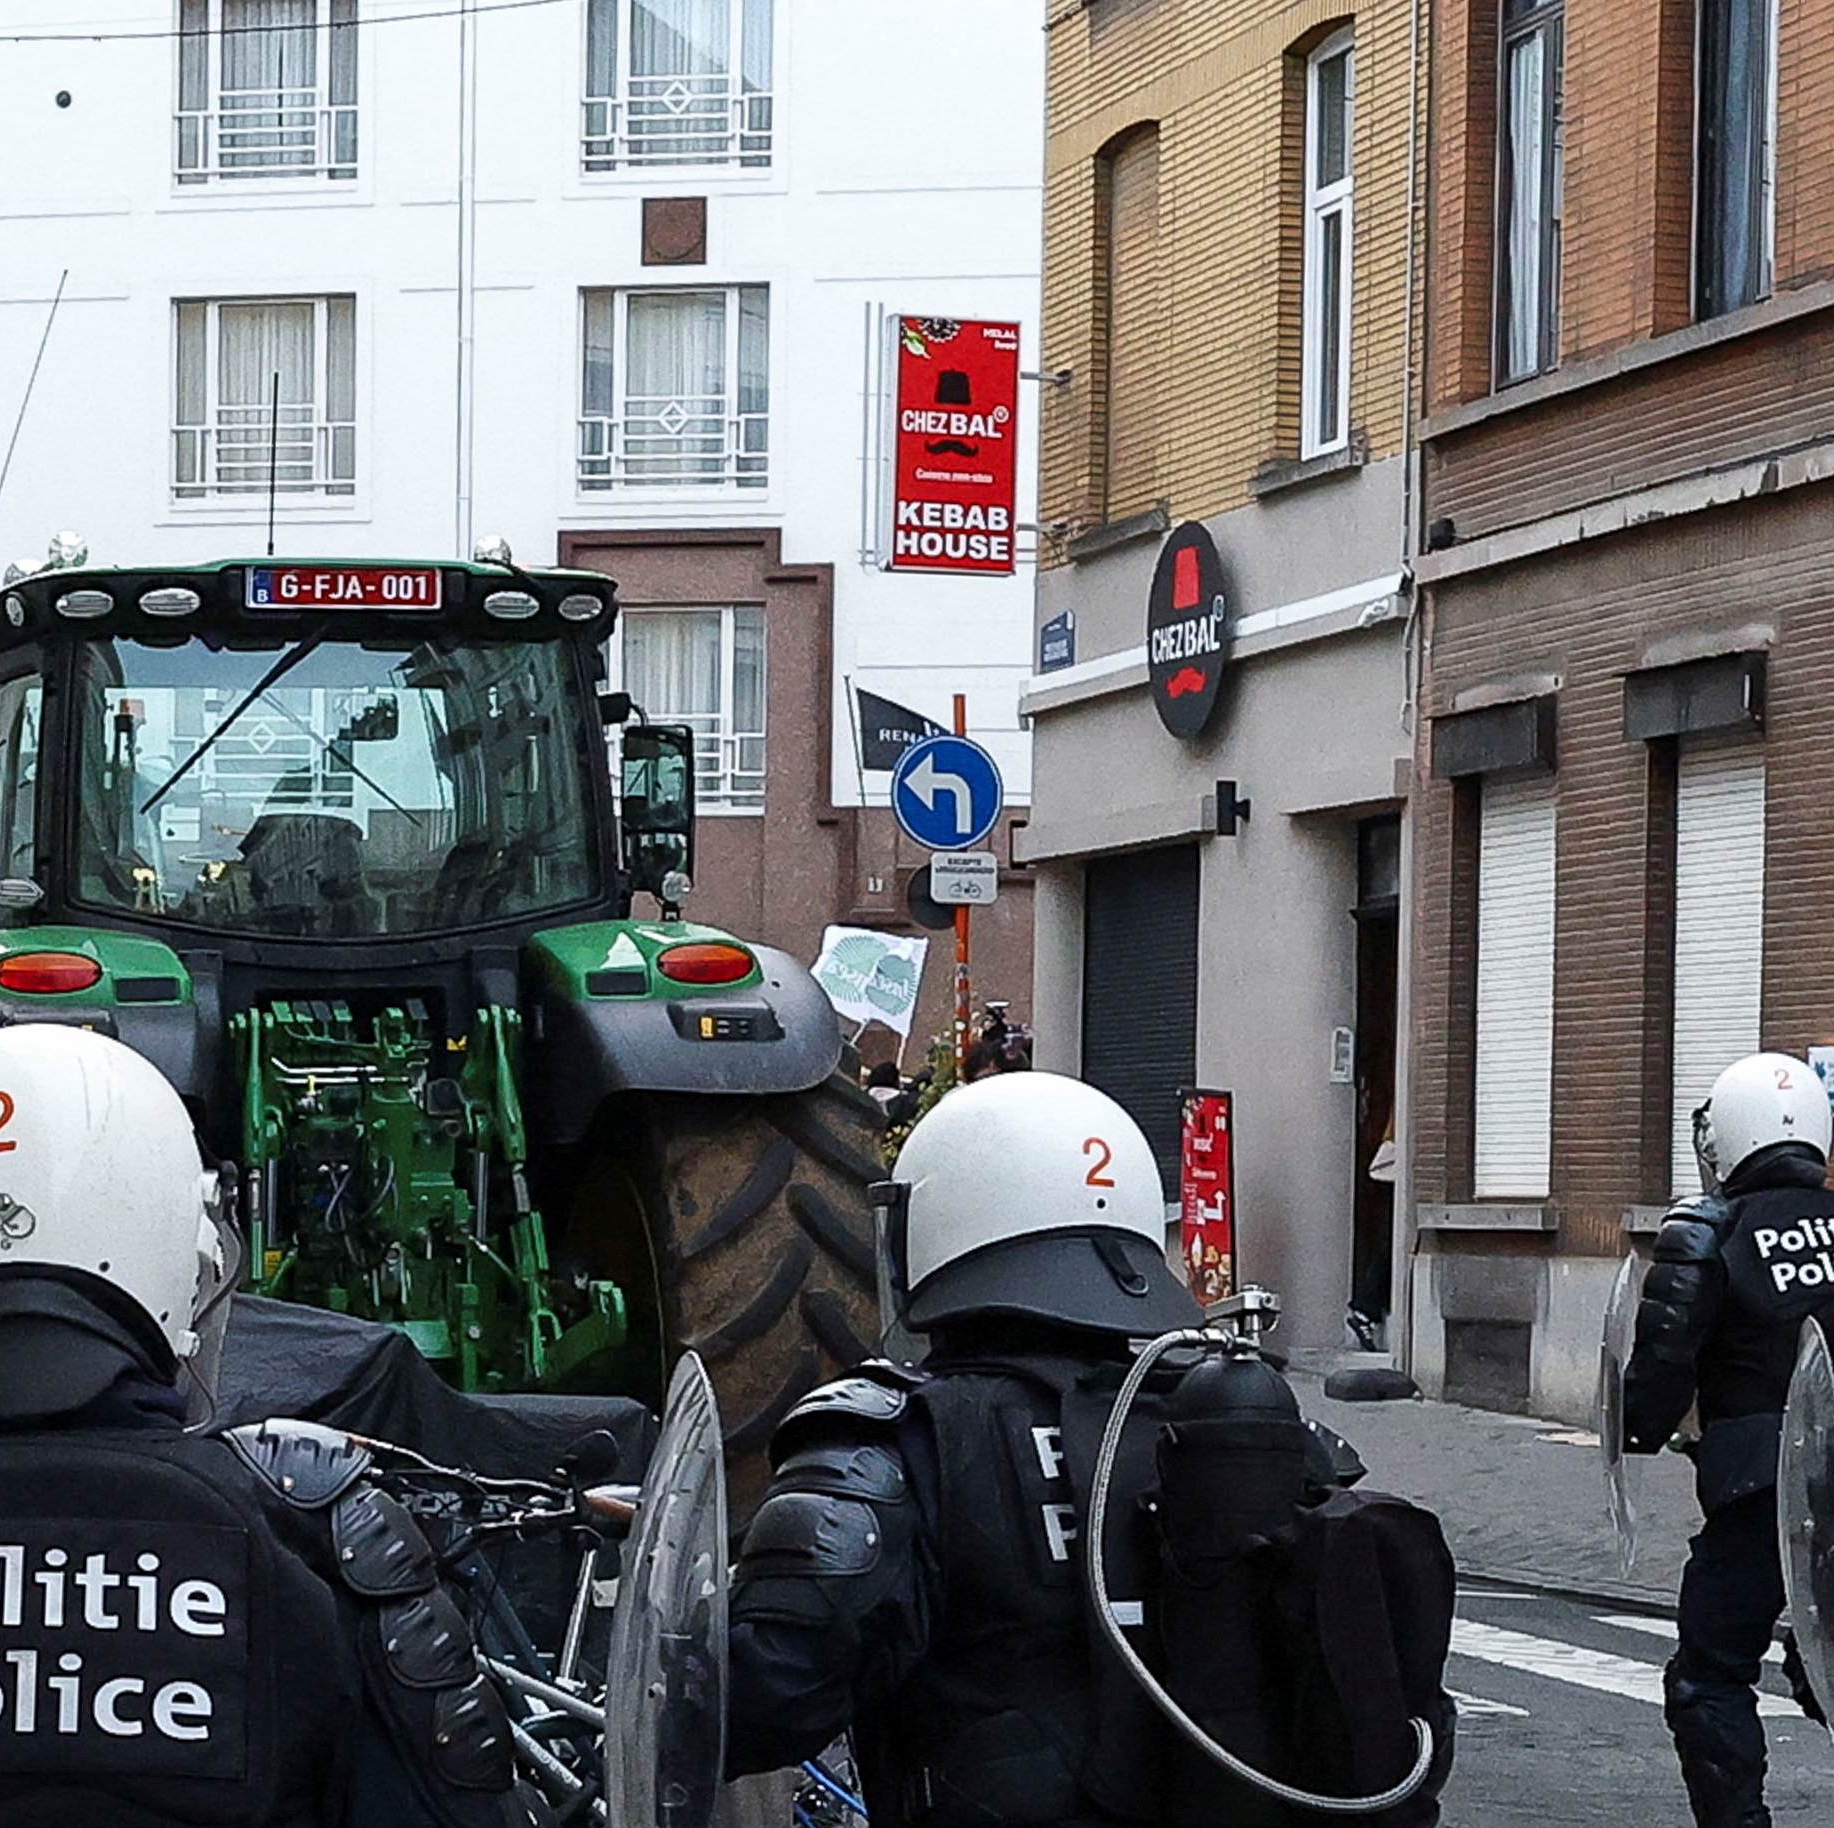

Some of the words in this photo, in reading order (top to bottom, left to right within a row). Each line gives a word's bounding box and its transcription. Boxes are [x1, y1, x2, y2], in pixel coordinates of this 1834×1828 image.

[898, 501, 1009, 531] KEBAB
[896, 531, 1009, 560] HOUSE
[256, 589, 268, 603] B
[280, 574, 427, 600] G-FJA-001
[1774, 1069, 1793, 1090] 2
[1082, 1137, 1115, 1188] 2
